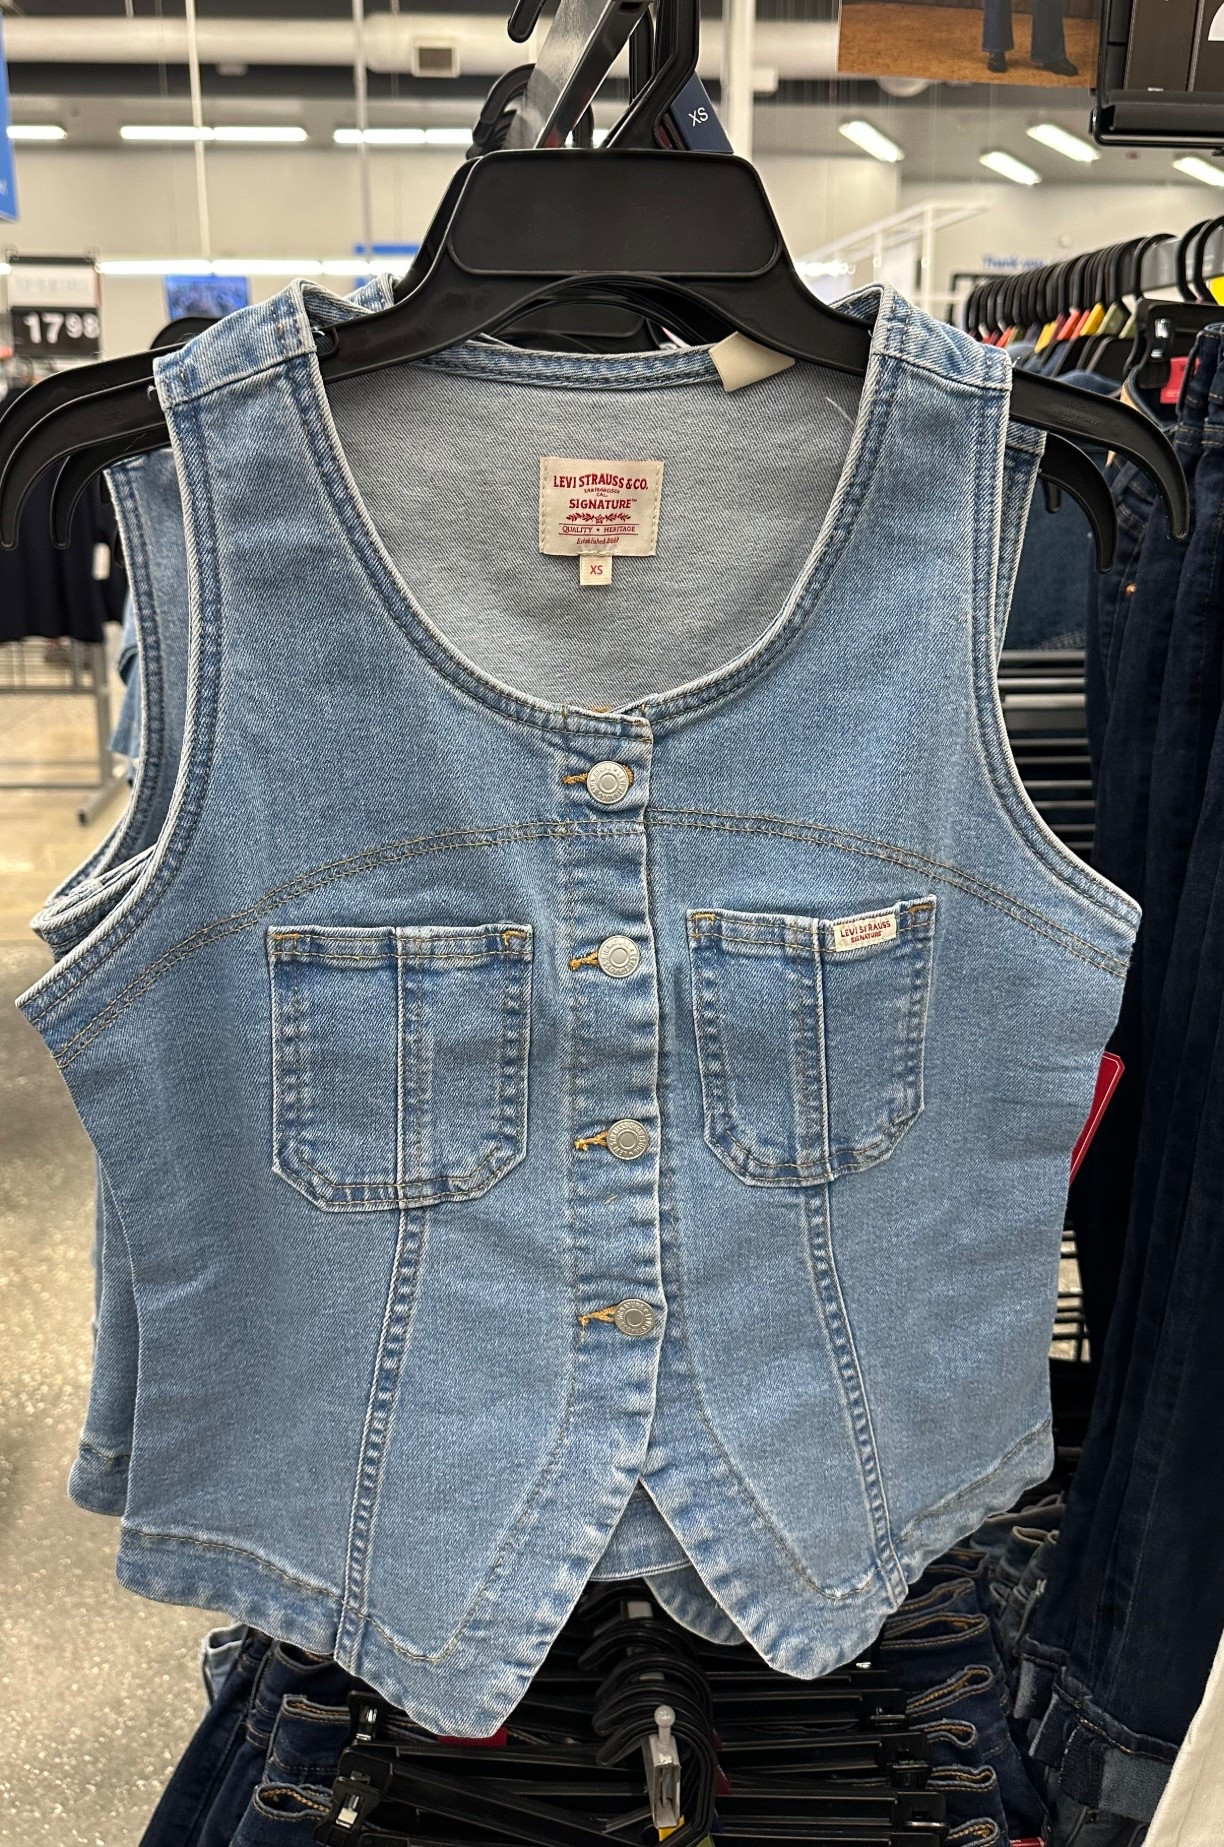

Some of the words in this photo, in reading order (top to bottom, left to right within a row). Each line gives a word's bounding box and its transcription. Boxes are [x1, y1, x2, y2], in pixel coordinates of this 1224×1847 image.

[687, 107, 709, 127] XS
[553, 475, 577, 489] LEVI
[578, 473, 624, 489] STRAUSS
[562, 526, 593, 534] QUALITY
[603, 525, 636, 533] HERITAGE
[589, 565, 603, 575] XS
[840, 926, 858, 938] LEVI
[859, 920, 891, 934] STRAUSS
